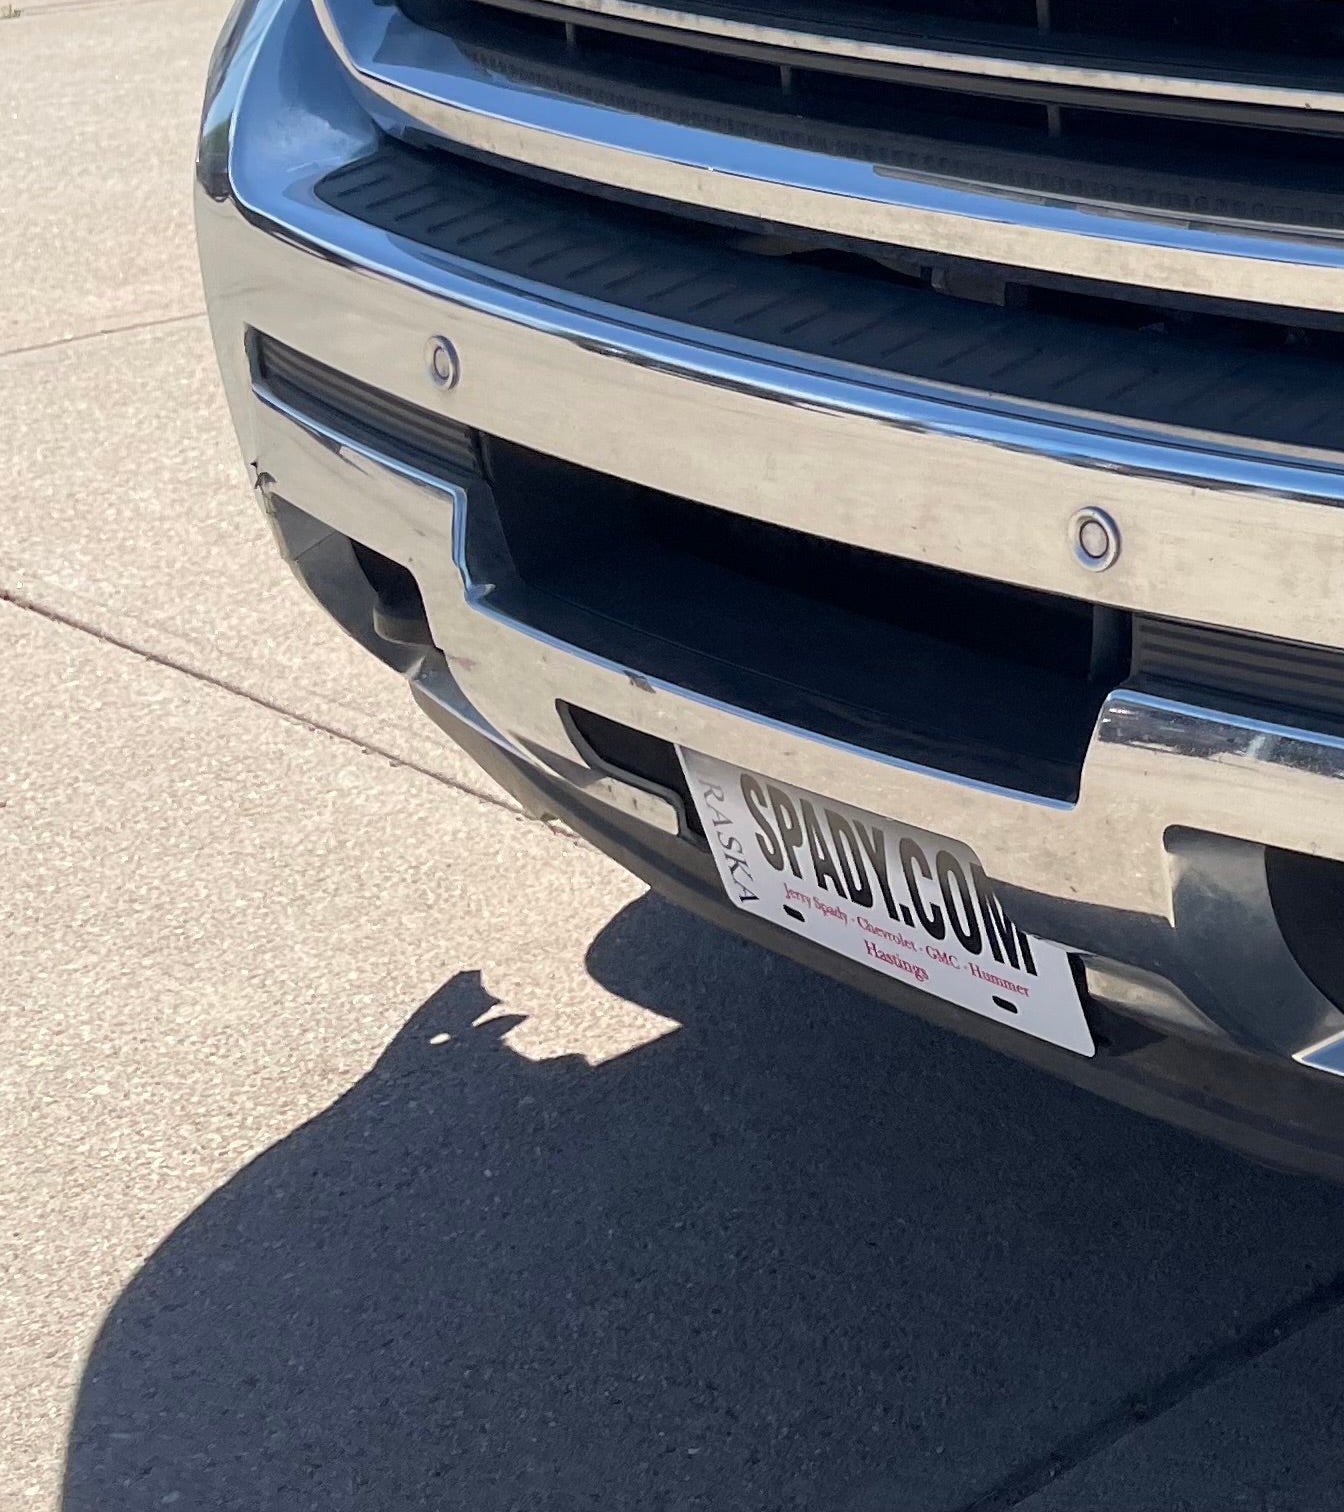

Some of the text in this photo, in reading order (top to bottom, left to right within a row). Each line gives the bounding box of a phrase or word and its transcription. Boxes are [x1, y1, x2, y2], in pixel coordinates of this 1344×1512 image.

[699, 778, 760, 903] RASKA
[739, 772, 1039, 977] SPADY.COM
[783, 882, 1030, 998] Jerry Spady Chevrolet GMC Hummer
[863, 938, 930, 984] Hastings
